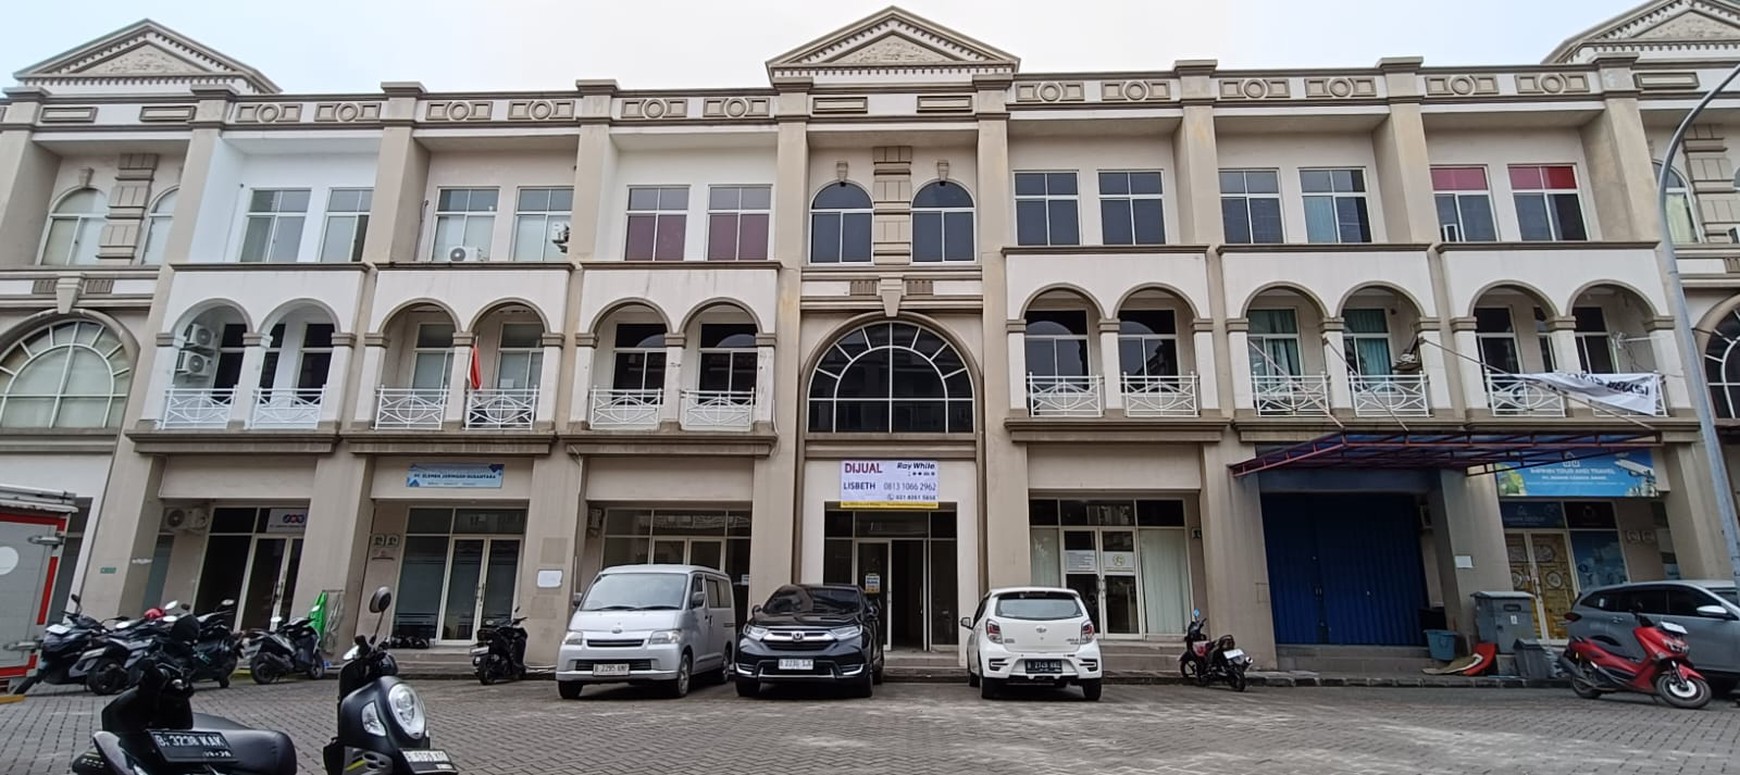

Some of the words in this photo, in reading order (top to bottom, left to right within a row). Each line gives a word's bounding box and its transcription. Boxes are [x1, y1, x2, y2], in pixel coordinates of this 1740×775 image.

[844, 462, 883, 474] DIJUAL
[897, 462, 912, 470] Ray
[843, 481, 876, 490] LISBETH
[883, 482, 900, 490] 0813
